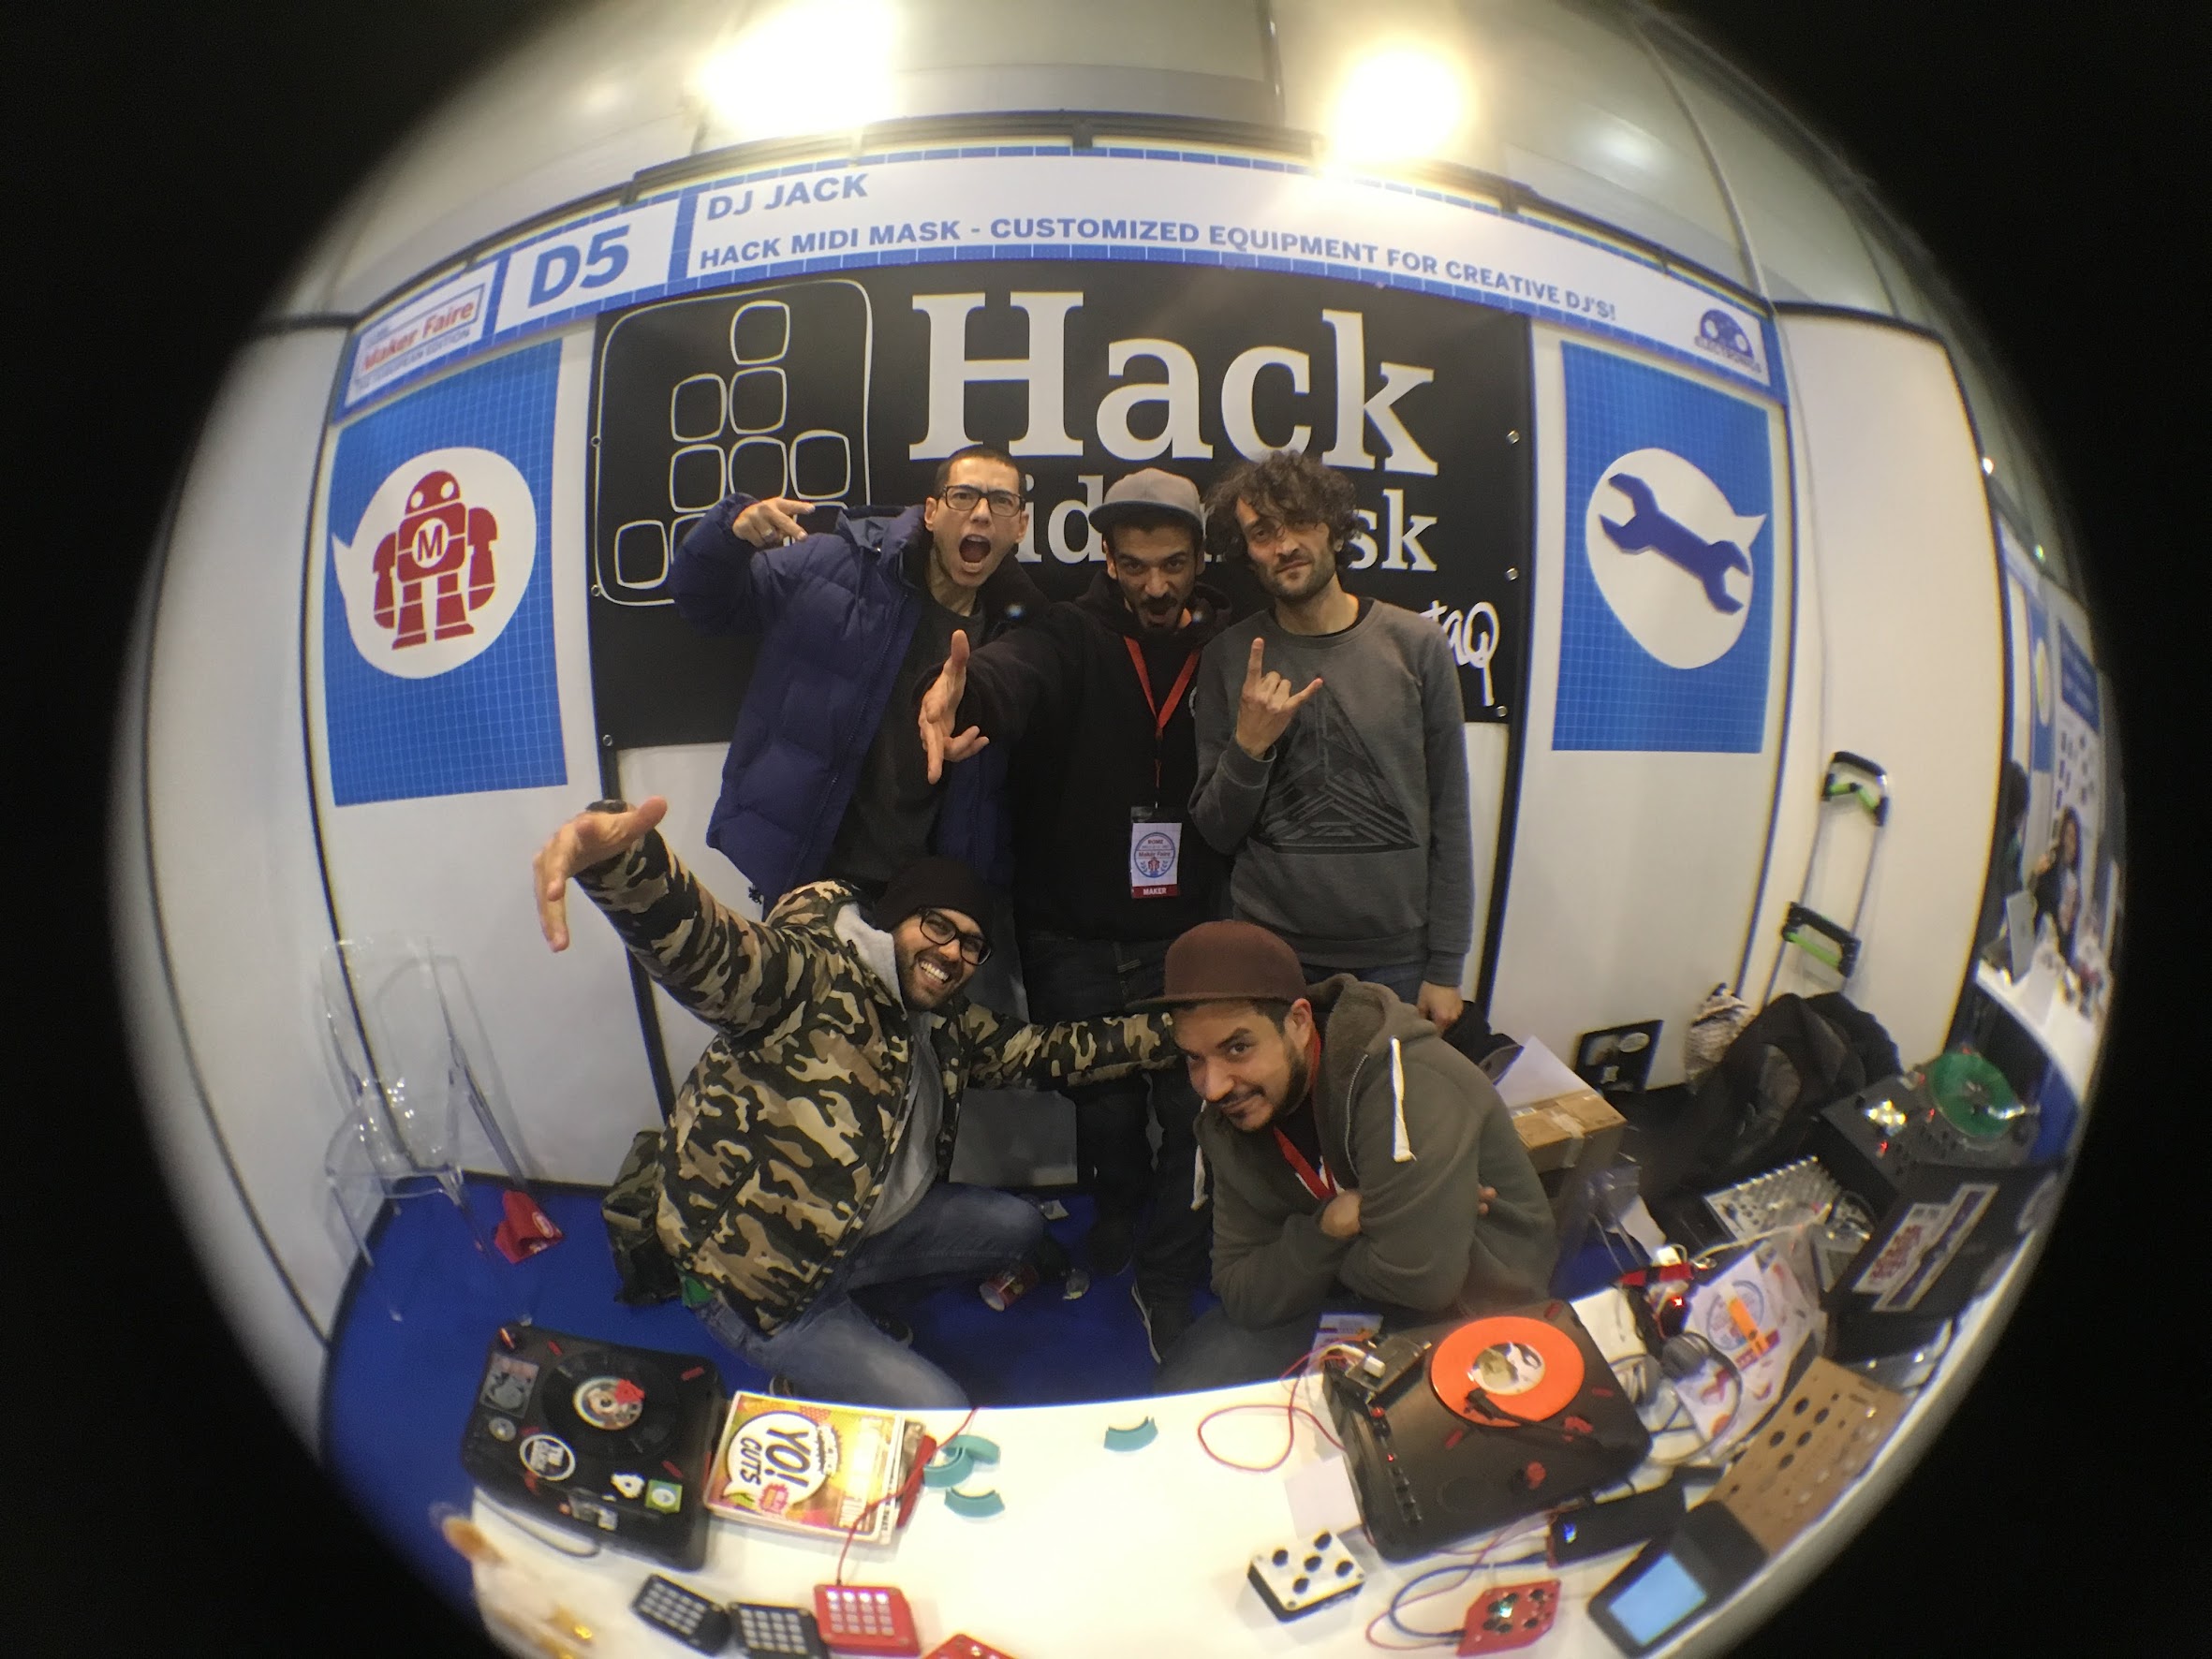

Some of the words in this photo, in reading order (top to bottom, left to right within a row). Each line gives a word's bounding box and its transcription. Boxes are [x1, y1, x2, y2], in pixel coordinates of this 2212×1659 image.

[707, 190, 753, 221] DJ
[763, 173, 868, 210] JACK
[526, 225, 631, 309] D5
[700, 238, 781, 270] HACK
[791, 228, 859, 255] MIDI
[869, 220, 961, 245] MASK
[990, 218, 1200, 243] CUSTOMIZED
[1209, 225, 1379, 263] EQUIPMENT
[1387, 247, 1438, 274] FOR
[1446, 260, 1560, 304] CREATIVE
[1565, 288, 1617, 321] DJ'S!
[421, 301, 475, 339] Faire
[908, 291, 1439, 476] Hack
[417, 523, 444, 563] M
[1143, 887, 1167, 896] MAKER
[739, 1436, 763, 1487] CUTS
[764, 1428, 811, 1489] YO!
